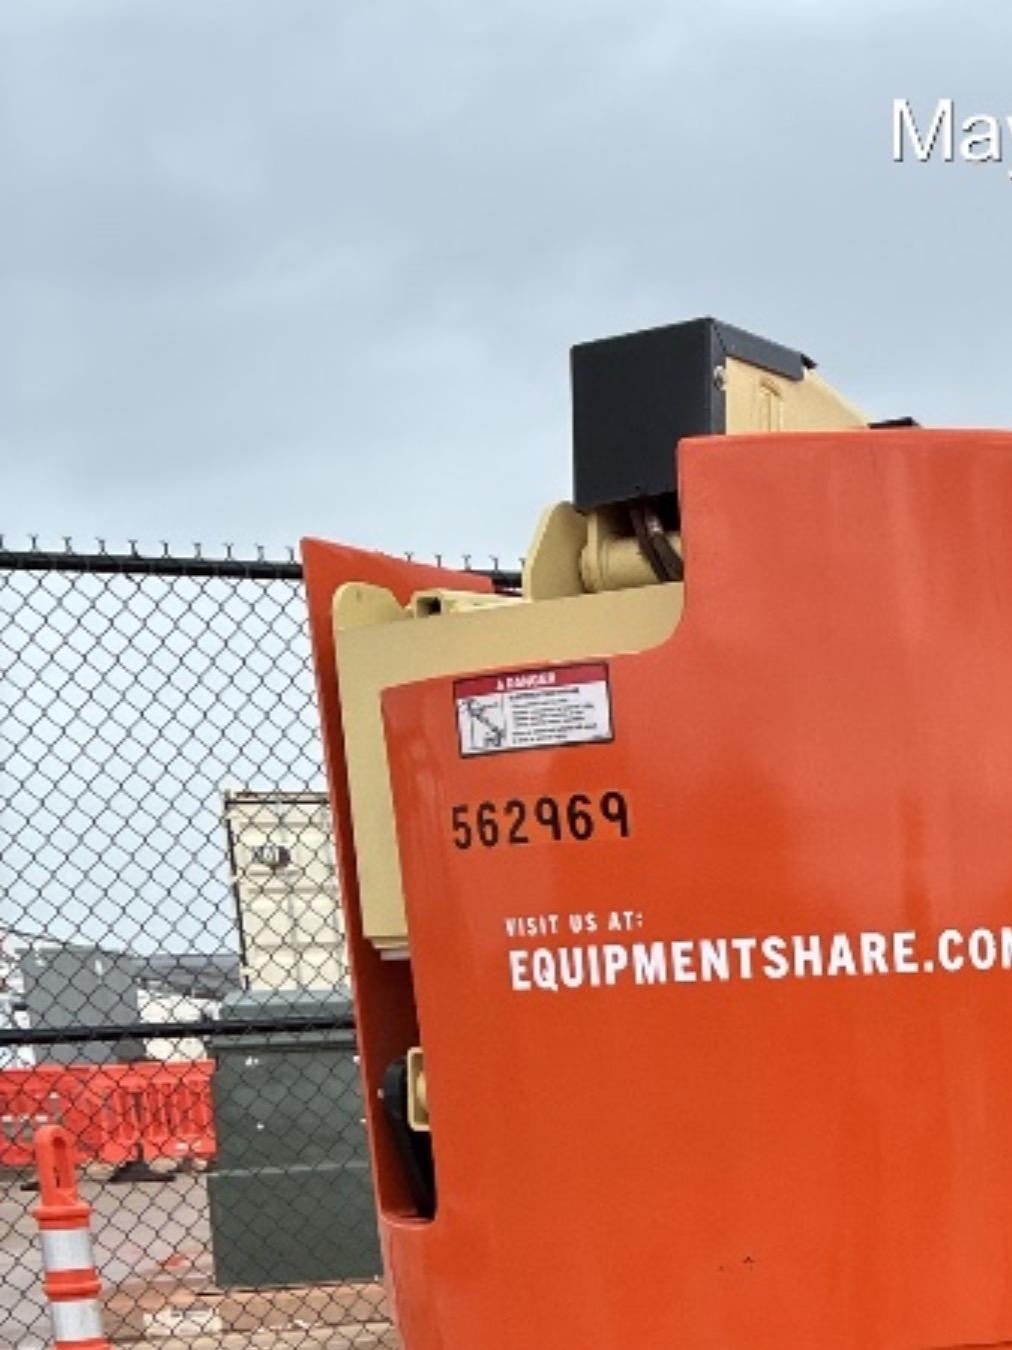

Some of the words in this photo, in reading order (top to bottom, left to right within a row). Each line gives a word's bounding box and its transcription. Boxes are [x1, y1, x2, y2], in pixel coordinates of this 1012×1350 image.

[451, 791, 631, 849] 562969
[505, 914, 559, 937] VISIT
[569, 912, 598, 934] US
[608, 911, 643, 931] AT:
